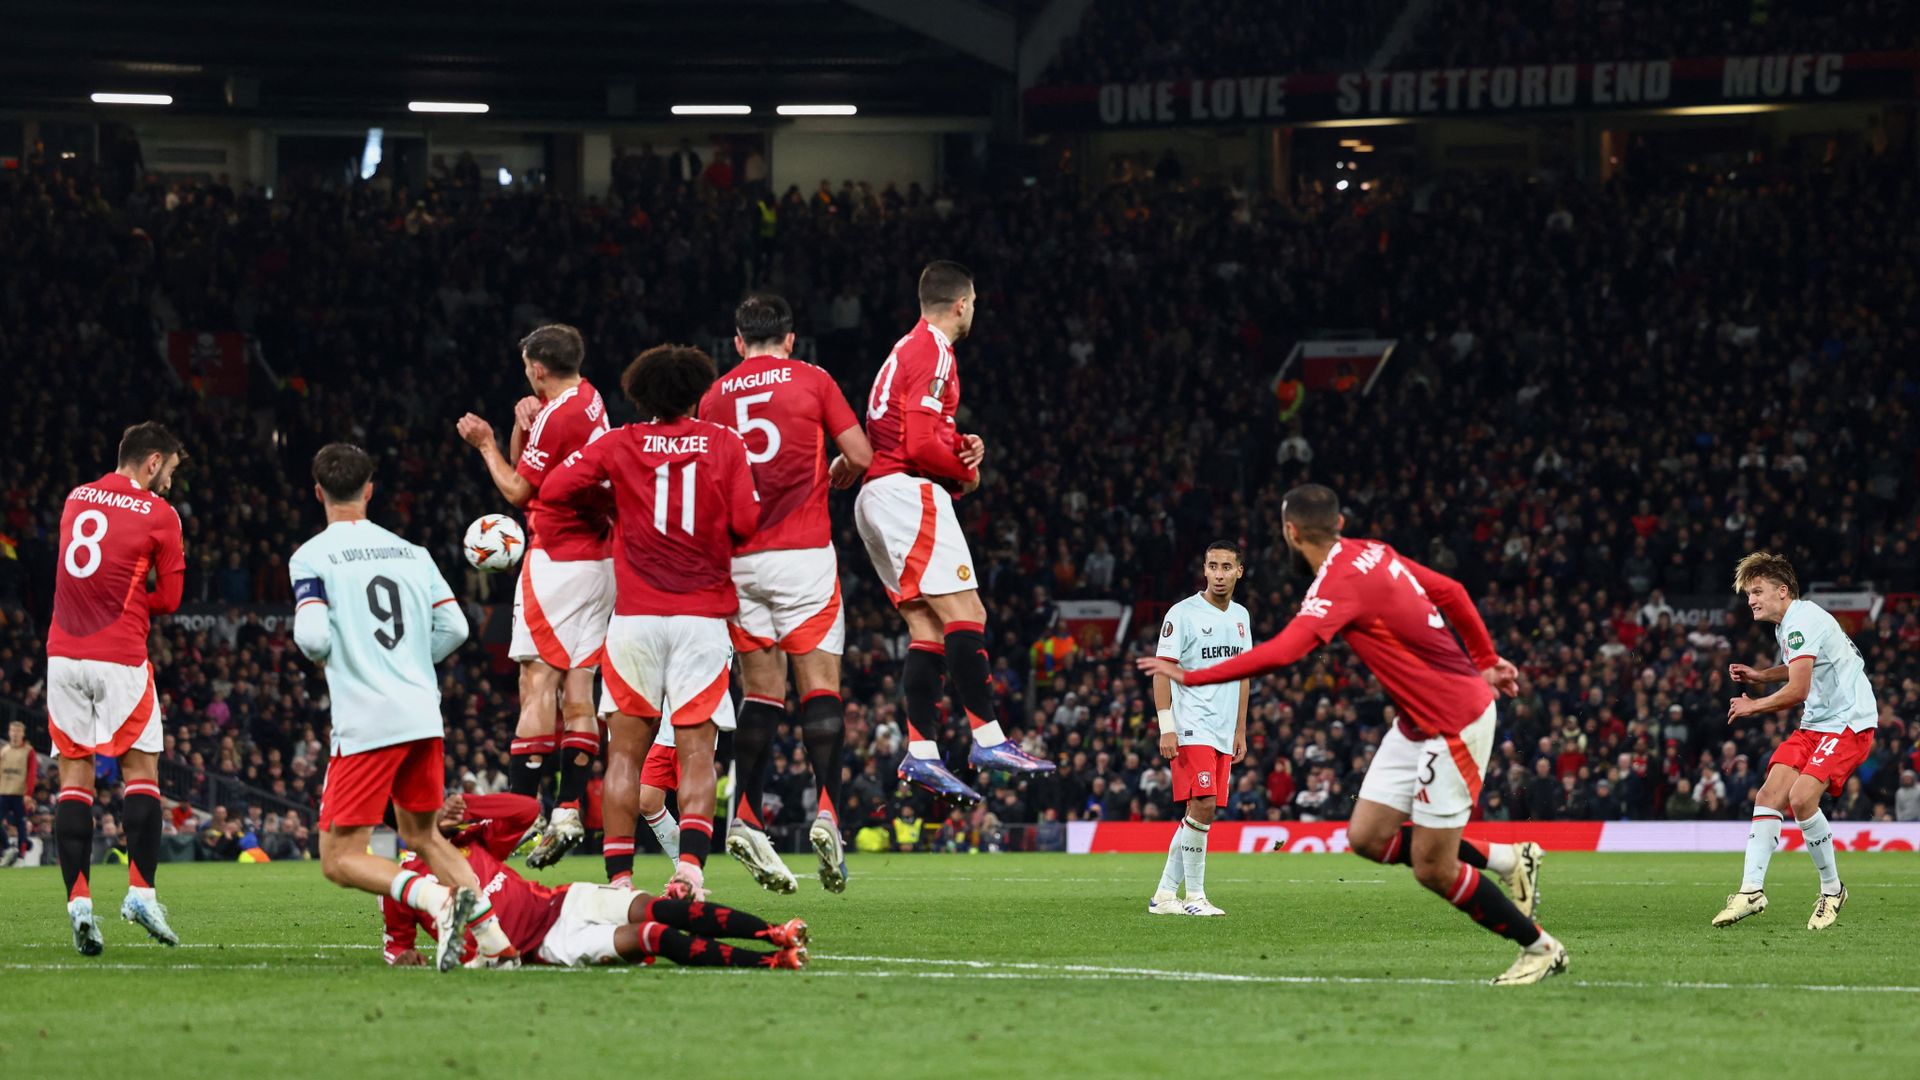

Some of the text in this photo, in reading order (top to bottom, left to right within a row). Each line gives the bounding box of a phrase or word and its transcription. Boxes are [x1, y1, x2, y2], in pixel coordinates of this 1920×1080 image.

[1100, 53, 1844, 124] ONE LOVE STRETFORD END MUFC
[721, 367, 793, 395] MAGUIRE
[642, 435, 709, 455] ZIRKZEE
[735, 391, 782, 463] 5
[653, 460, 697, 537] 11
[64, 508, 109, 579] 8
[366, 575, 405, 650] 9
[1418, 750, 1439, 786] 3
[1814, 735, 1840, 757] 14
